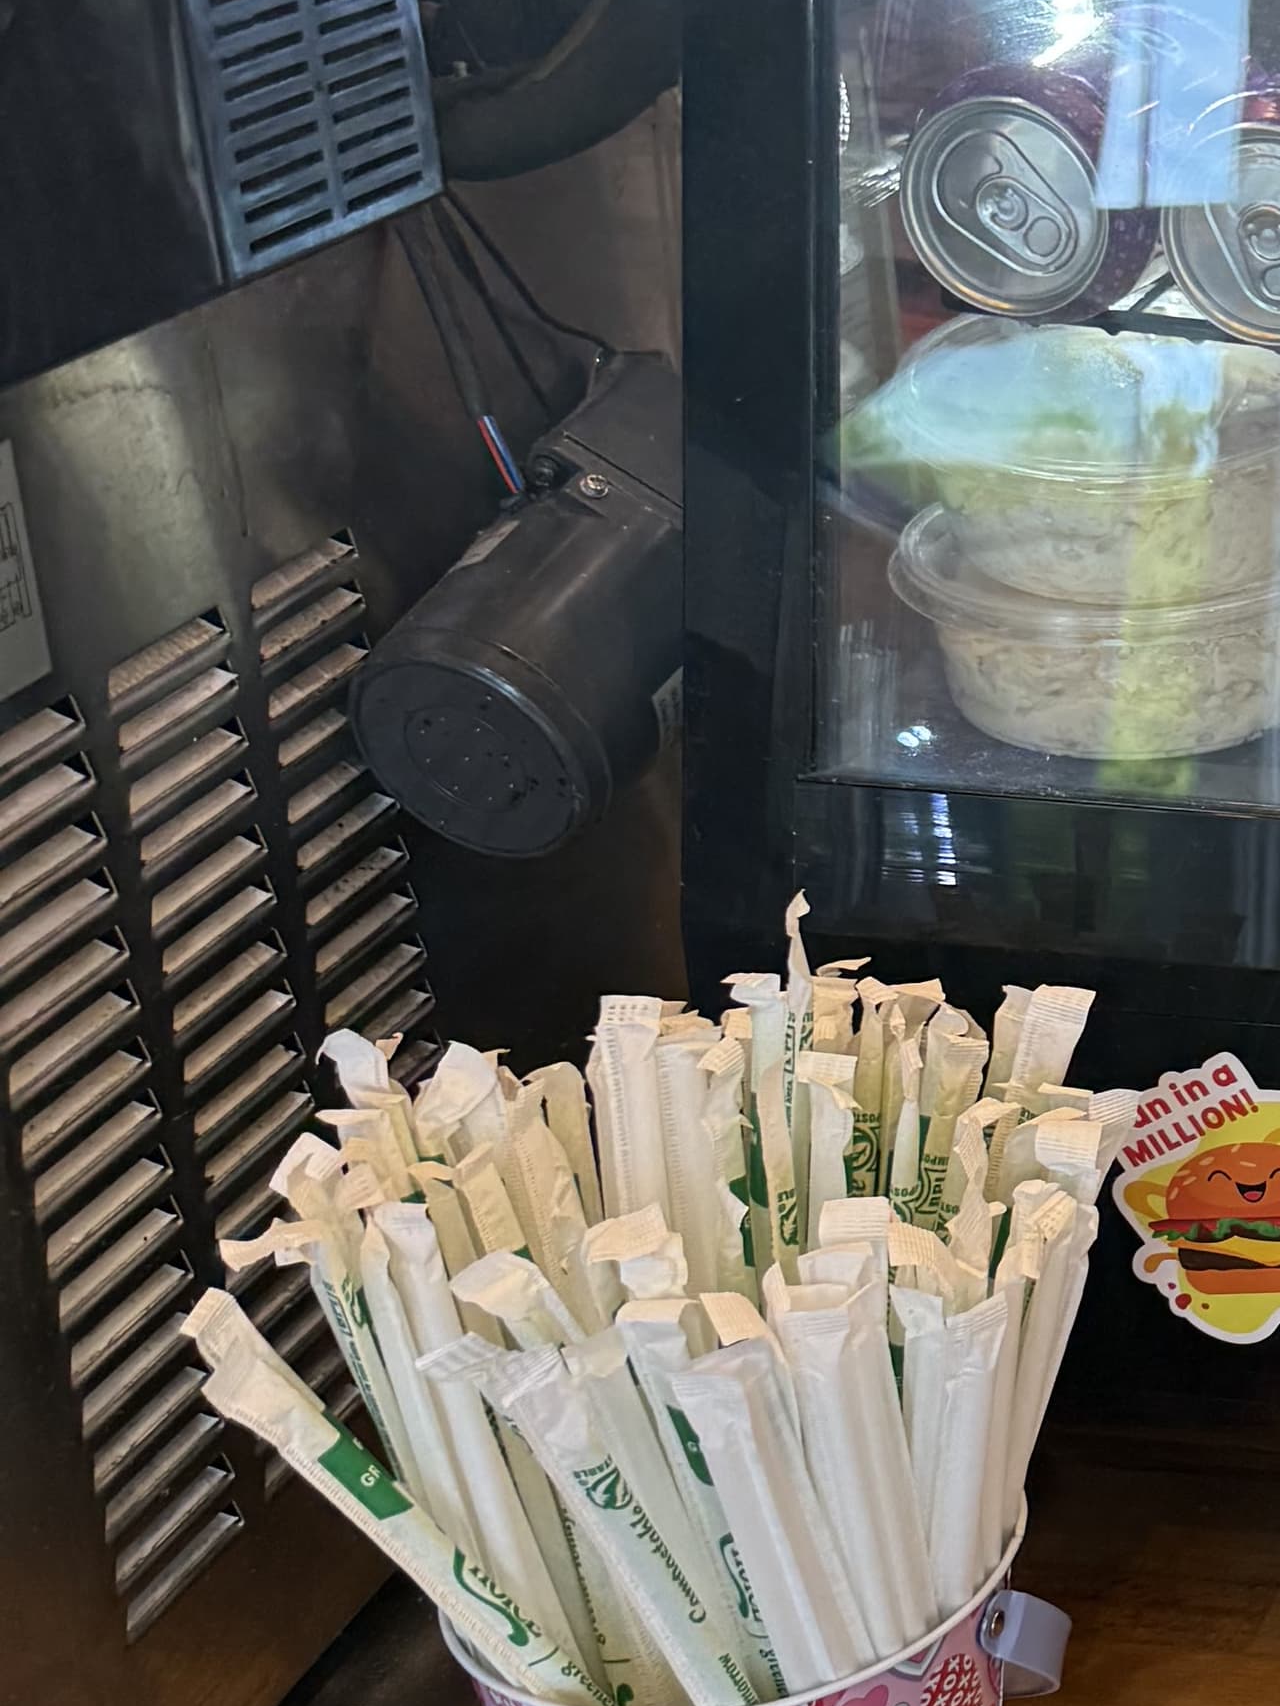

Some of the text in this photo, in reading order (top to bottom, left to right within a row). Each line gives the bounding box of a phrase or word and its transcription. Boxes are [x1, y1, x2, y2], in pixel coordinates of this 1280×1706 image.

[1169, 1079, 1210, 1108] in
[1212, 1063, 1239, 1087] a
[1122, 1088, 1259, 1168] MILLION!
